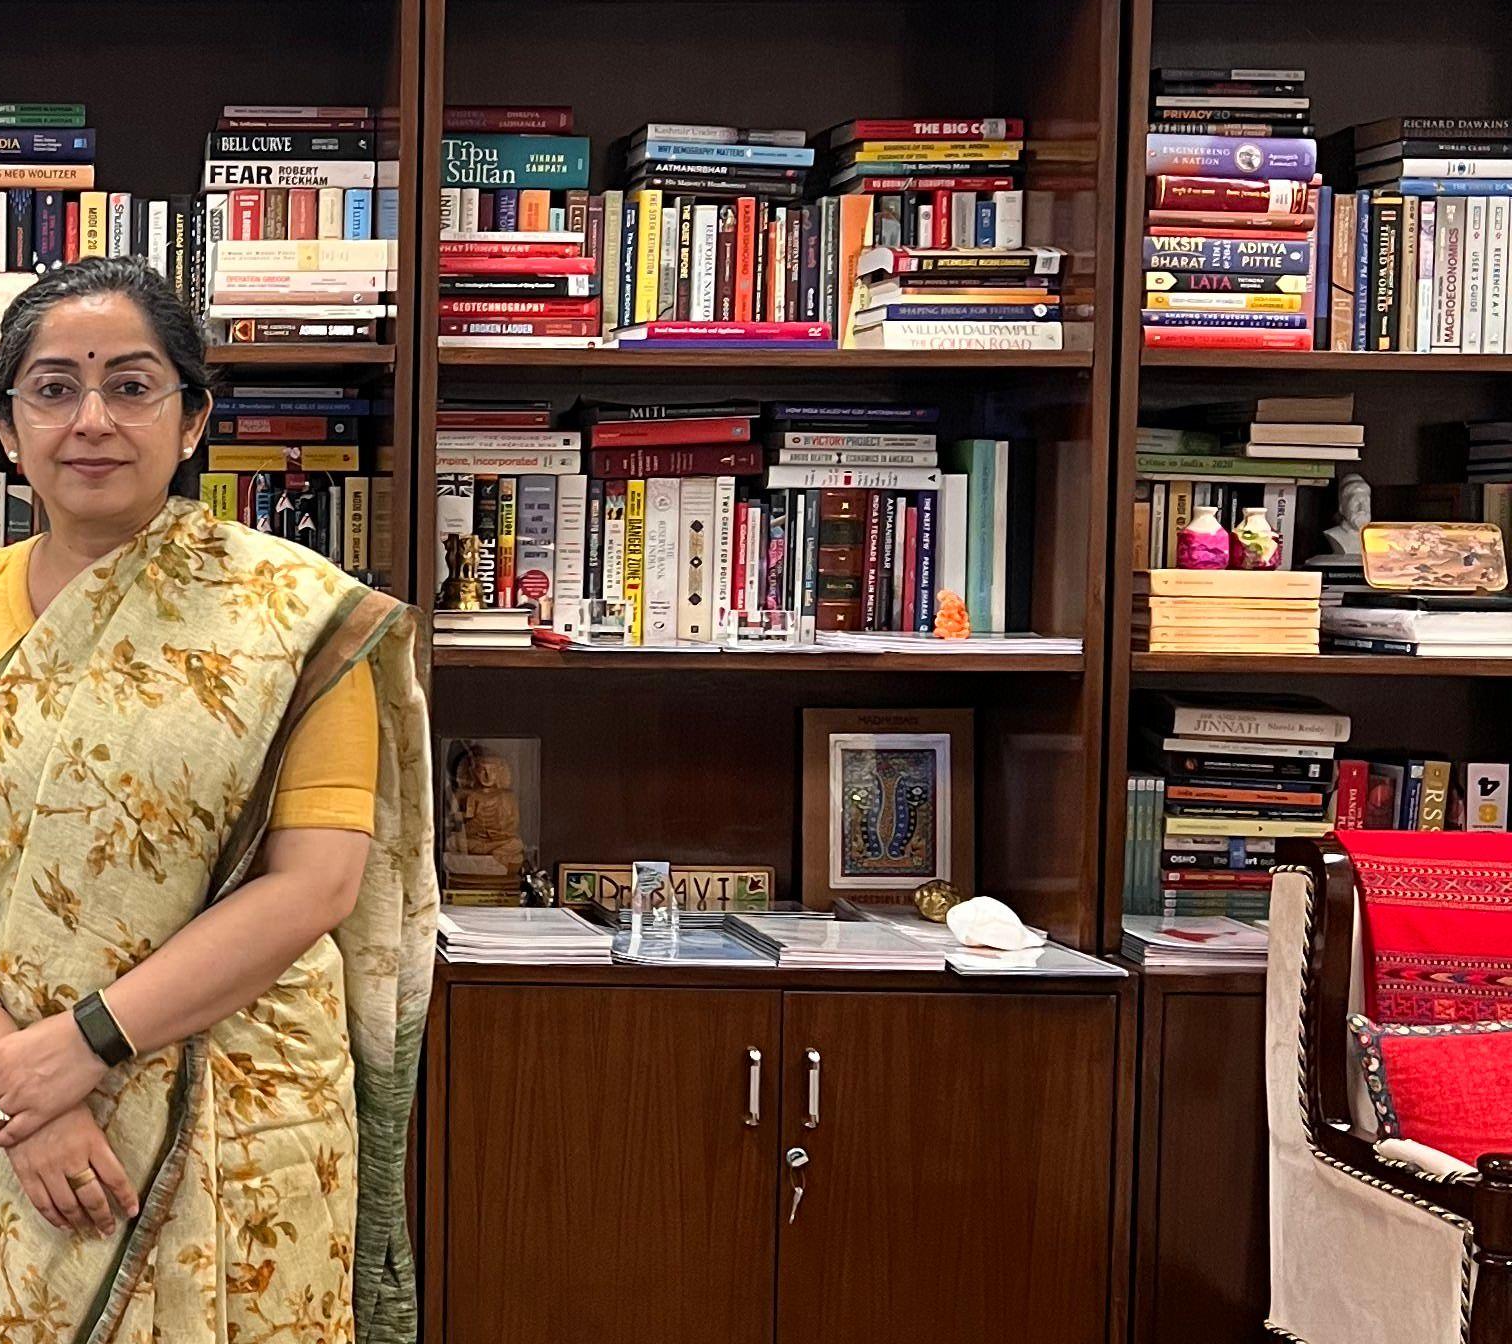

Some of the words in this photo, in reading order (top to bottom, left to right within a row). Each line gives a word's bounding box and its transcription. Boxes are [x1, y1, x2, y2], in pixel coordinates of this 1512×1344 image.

[1163, 110, 1213, 119] PRIVACY
[913, 123, 939, 134] THE
[943, 123, 968, 134] BIG
[1403, 120, 1455, 128] RICHARD
[1458, 120, 1509, 129] DAWKINS
[222, 137, 250, 151] BELL
[252, 137, 292, 151] CURVE
[672, 145, 714, 155] DEMOGRAPHY
[716, 148, 745, 157] MATTERS
[1163, 146, 1231, 156] ENGINEERING
[442, 140, 498, 168] Tipu
[529, 154, 564, 162] VIKRAM
[1182, 157, 1219, 165] NATION
[210, 165, 272, 184] FEAR
[278, 166, 318, 175] ROBERT
[447, 161, 516, 183] Sultan
[525, 164, 568, 173] SAMPATH
[656, 163, 727, 174] AATMANIRBHAR
[278, 176, 328, 185] PECKHAM
[88, 208, 98, 227] MODI
[440, 194, 452, 230] INDIA
[682, 204, 690, 220] THE
[681, 222, 689, 245] QUIET
[1408, 222, 1414, 232] TO
[88, 240, 98, 250] 20
[502, 245, 530, 253] WANT
[646, 232, 656, 275] EXTINCTION
[704, 224, 714, 276] REFORM
[1151, 237, 1207, 252] VIKSIT
[1212, 240, 1220, 267] INDIA
[1238, 242, 1287, 254] ADITYA
[1378, 224, 1389, 265] THIRD
[624, 246, 633, 272] Triangle
[680, 247, 689, 279] BEFORE
[1151, 256, 1206, 269] BHARAT
[1241, 257, 1282, 268] PITTIE
[1471, 251, 1479, 281] USER'S
[625, 274, 632, 282] of
[1360, 265, 1368, 278] The
[1492, 247, 1502, 298] REFERENCE
[1190, 275, 1232, 290] LATA
[1377, 268, 1388, 313] WORLD
[1444, 228, 1459, 343] MACROECONOMICS
[453, 302, 545, 312] GEOTECHNOGRAPHY
[1359, 283, 1367, 319] TULLY
[1470, 284, 1478, 313] GUIDE
[502, 323, 533, 334] LADDER
[902, 326, 959, 335] WILLIAM
[963, 325, 1039, 336] DALRYMPLE
[1358, 322, 1367, 352] MARK
[912, 338, 927, 346] THE
[930, 338, 985, 349] GOLDEN
[990, 338, 1032, 349] ROAD
[629, 407, 666, 418] MITI
[812, 436, 845, 445] VICTORY
[846, 436, 881, 446] PROJECT
[473, 456, 538, 467] Incorporated
[889, 455, 914, 463] AMERICA
[1139, 458, 1166, 467] Crime
[1180, 459, 1204, 468] India
[352, 491, 362, 511] MODI
[722, 495, 730, 513] TWO
[923, 497, 931, 511] THE
[1177, 495, 1187, 515] MODI
[1277, 499, 1286, 518] GIRL
[352, 523, 362, 533] 20
[504, 503, 512, 536] BILLION
[923, 512, 931, 531] NEXT
[627, 518, 642, 555] DANGER
[649, 529, 656, 542] OF
[657, 519, 666, 553] RESERVE
[884, 498, 894, 569] AATMANIRBHAR
[922, 532, 930, 550] NEW
[667, 542, 675, 559] THE
[869, 525, 878, 562] TECHADE
[647, 543, 655, 571] INDIA
[475, 538, 495, 604] EUROPE
[627, 557, 640, 581] ZONE
[657, 555, 665, 580] BANK
[921, 556, 929, 588] PRANJAL
[719, 566, 727, 600] POLITICS
[866, 594, 875, 622] MEHTA
[920, 590, 929, 620] SHARMA
[1194, 719, 1261, 734] JINNAH
